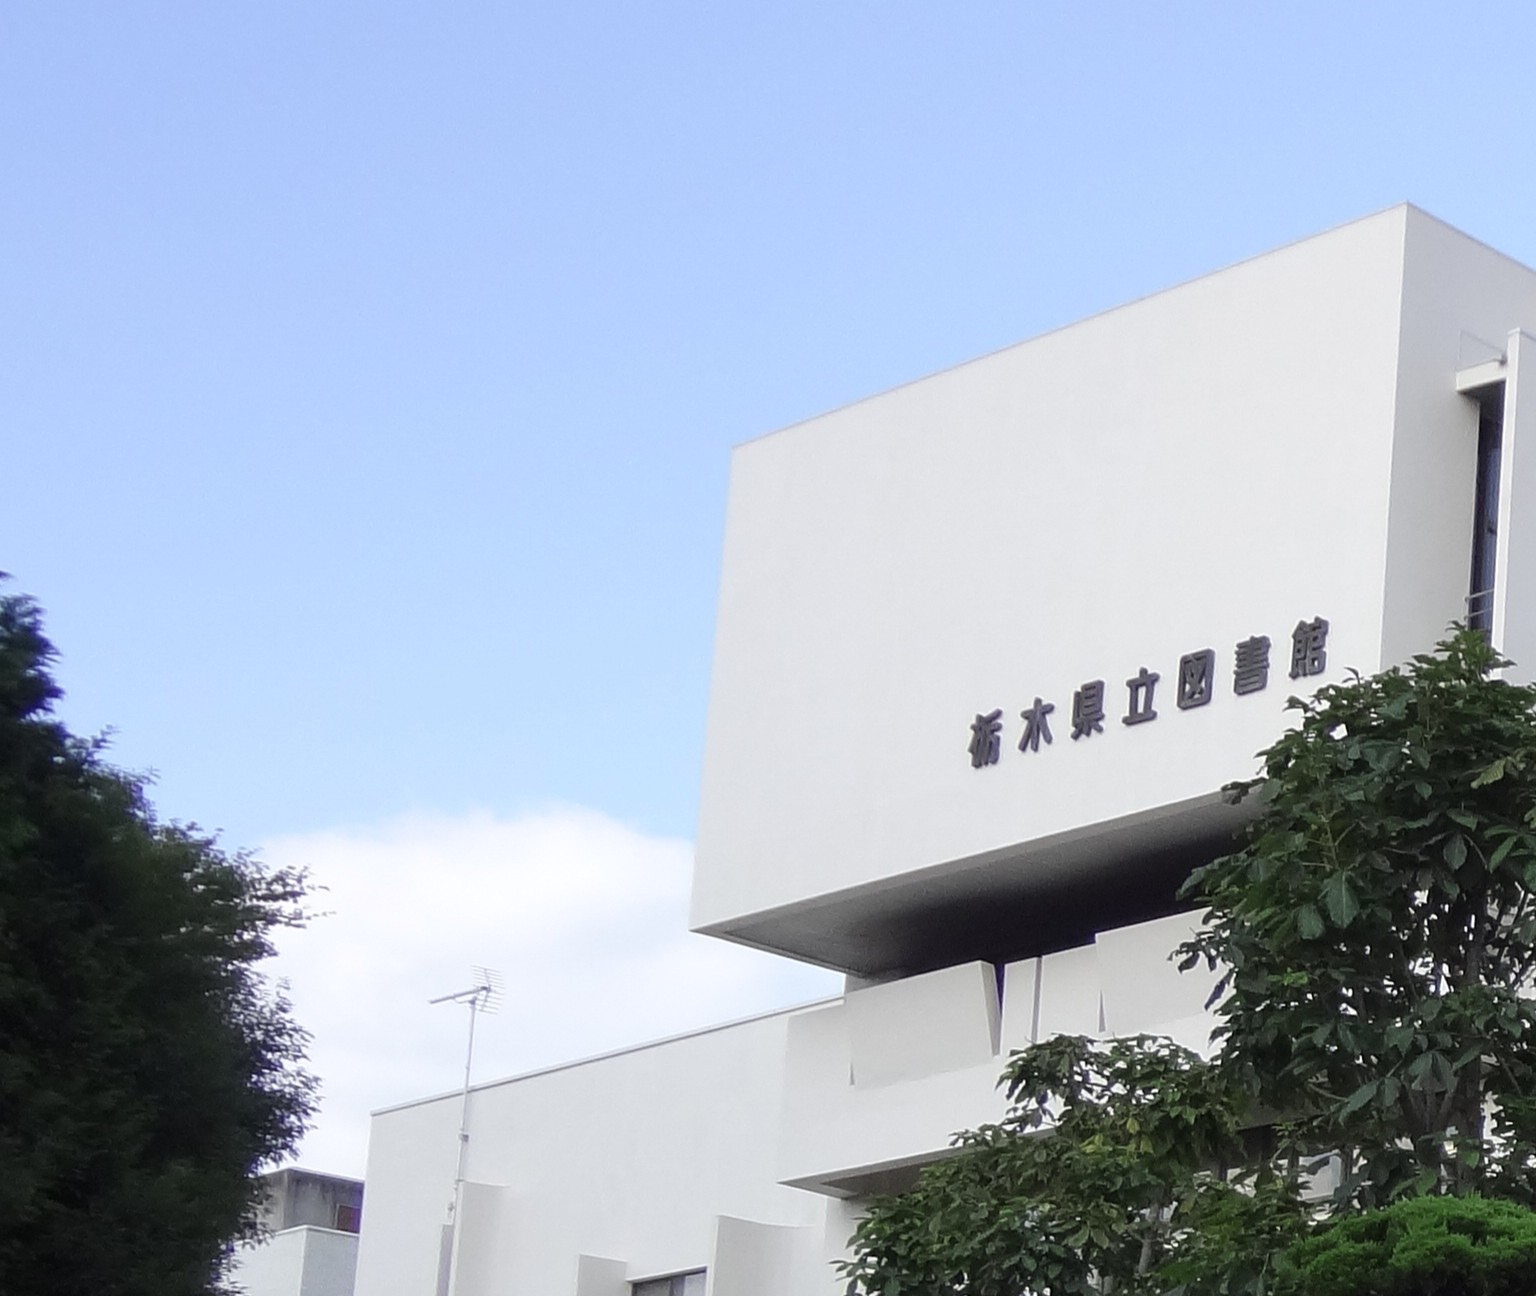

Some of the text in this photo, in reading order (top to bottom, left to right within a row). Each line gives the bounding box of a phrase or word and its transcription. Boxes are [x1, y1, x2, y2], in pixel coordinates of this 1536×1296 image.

[967, 615, 1330, 769] 栃木県立図書館
